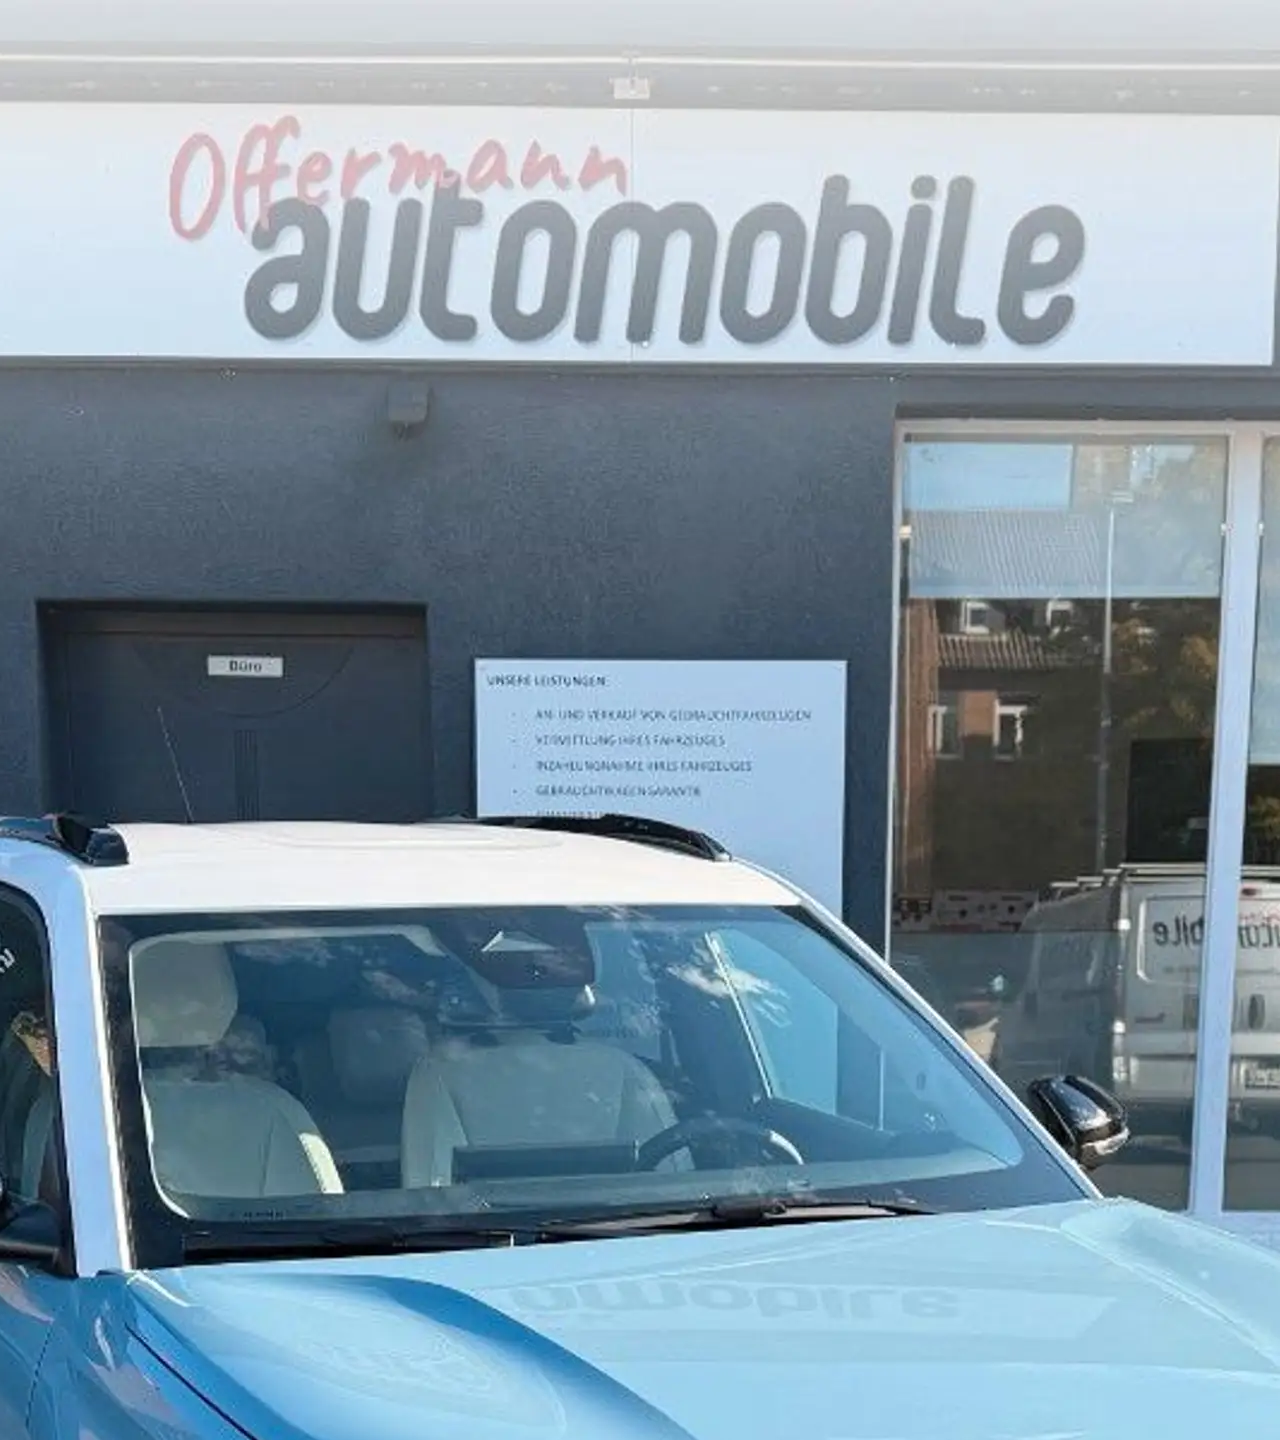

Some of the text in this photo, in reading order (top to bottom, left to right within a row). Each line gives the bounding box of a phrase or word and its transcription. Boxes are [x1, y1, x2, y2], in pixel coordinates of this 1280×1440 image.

[169, 115, 628, 240] Offermann
[244, 170, 1086, 345] automobile
[485, 674, 531, 687] UNSERE
[639, 708, 666, 720] VON
